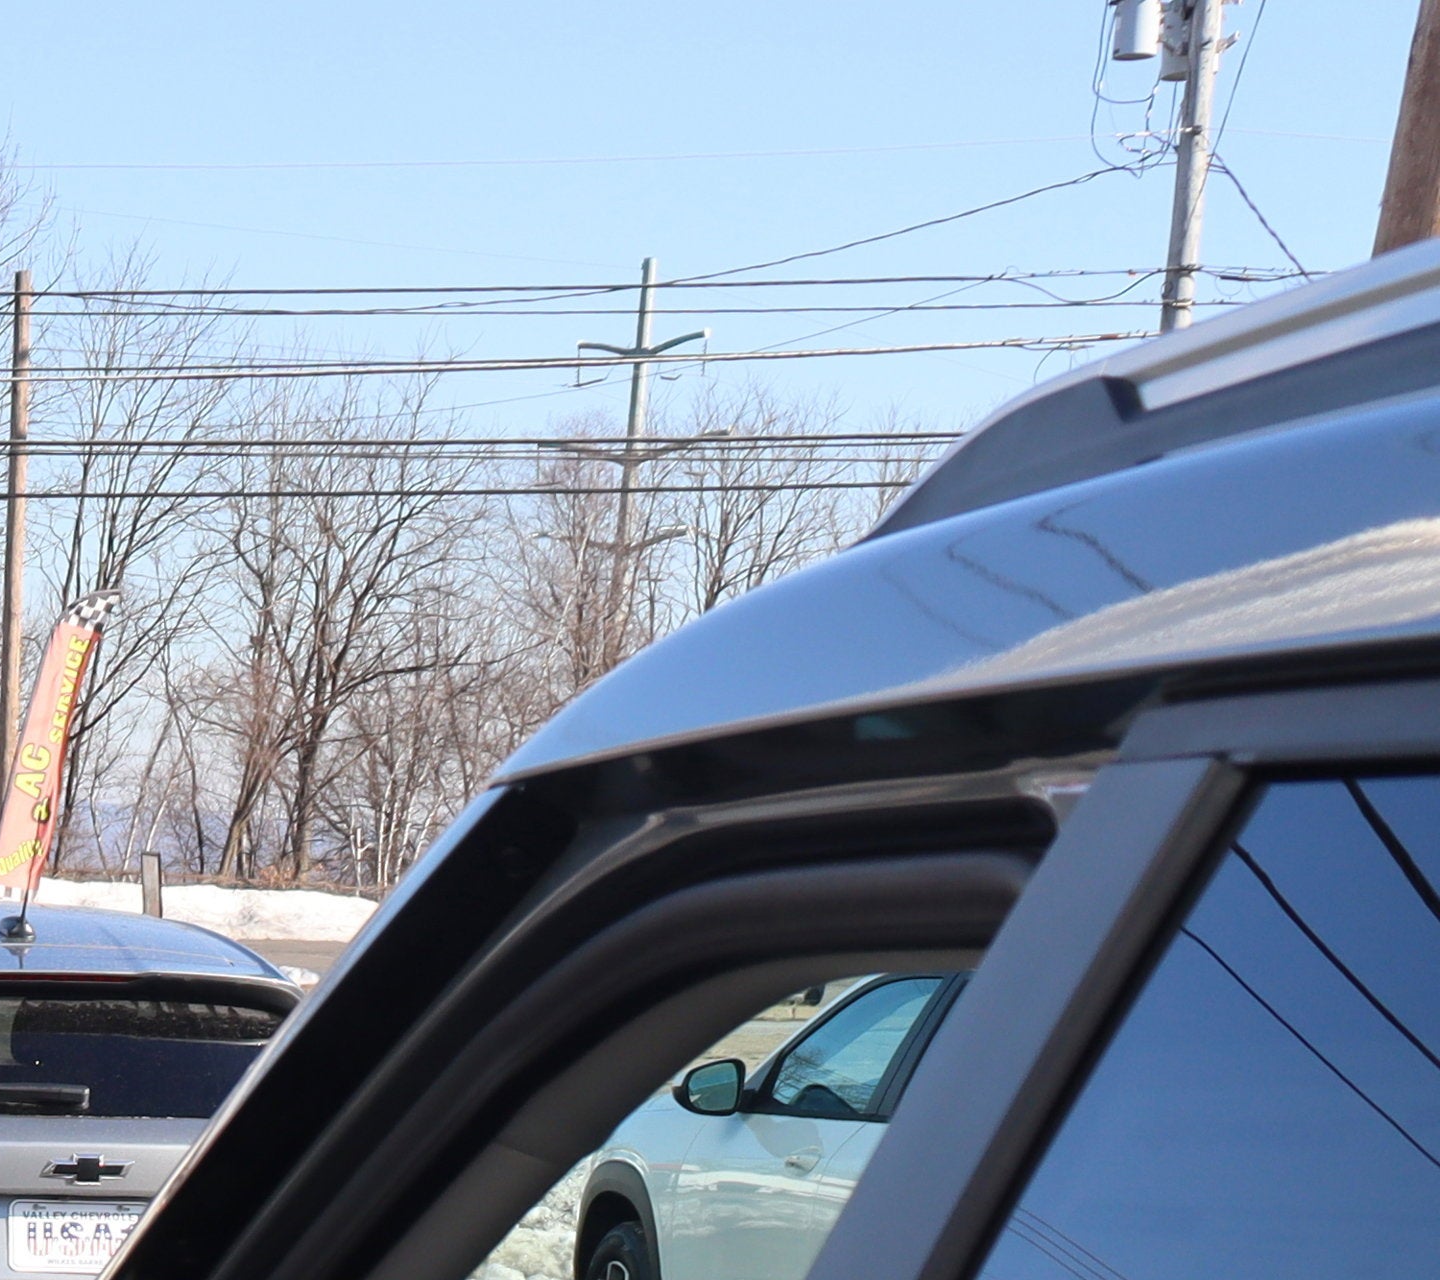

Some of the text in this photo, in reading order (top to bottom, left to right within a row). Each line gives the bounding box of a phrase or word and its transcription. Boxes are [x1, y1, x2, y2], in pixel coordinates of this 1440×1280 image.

[48, 634, 92, 745] SERVICE
[14, 742, 51, 799] AC
[22, 1210, 68, 1220] VALLEY
